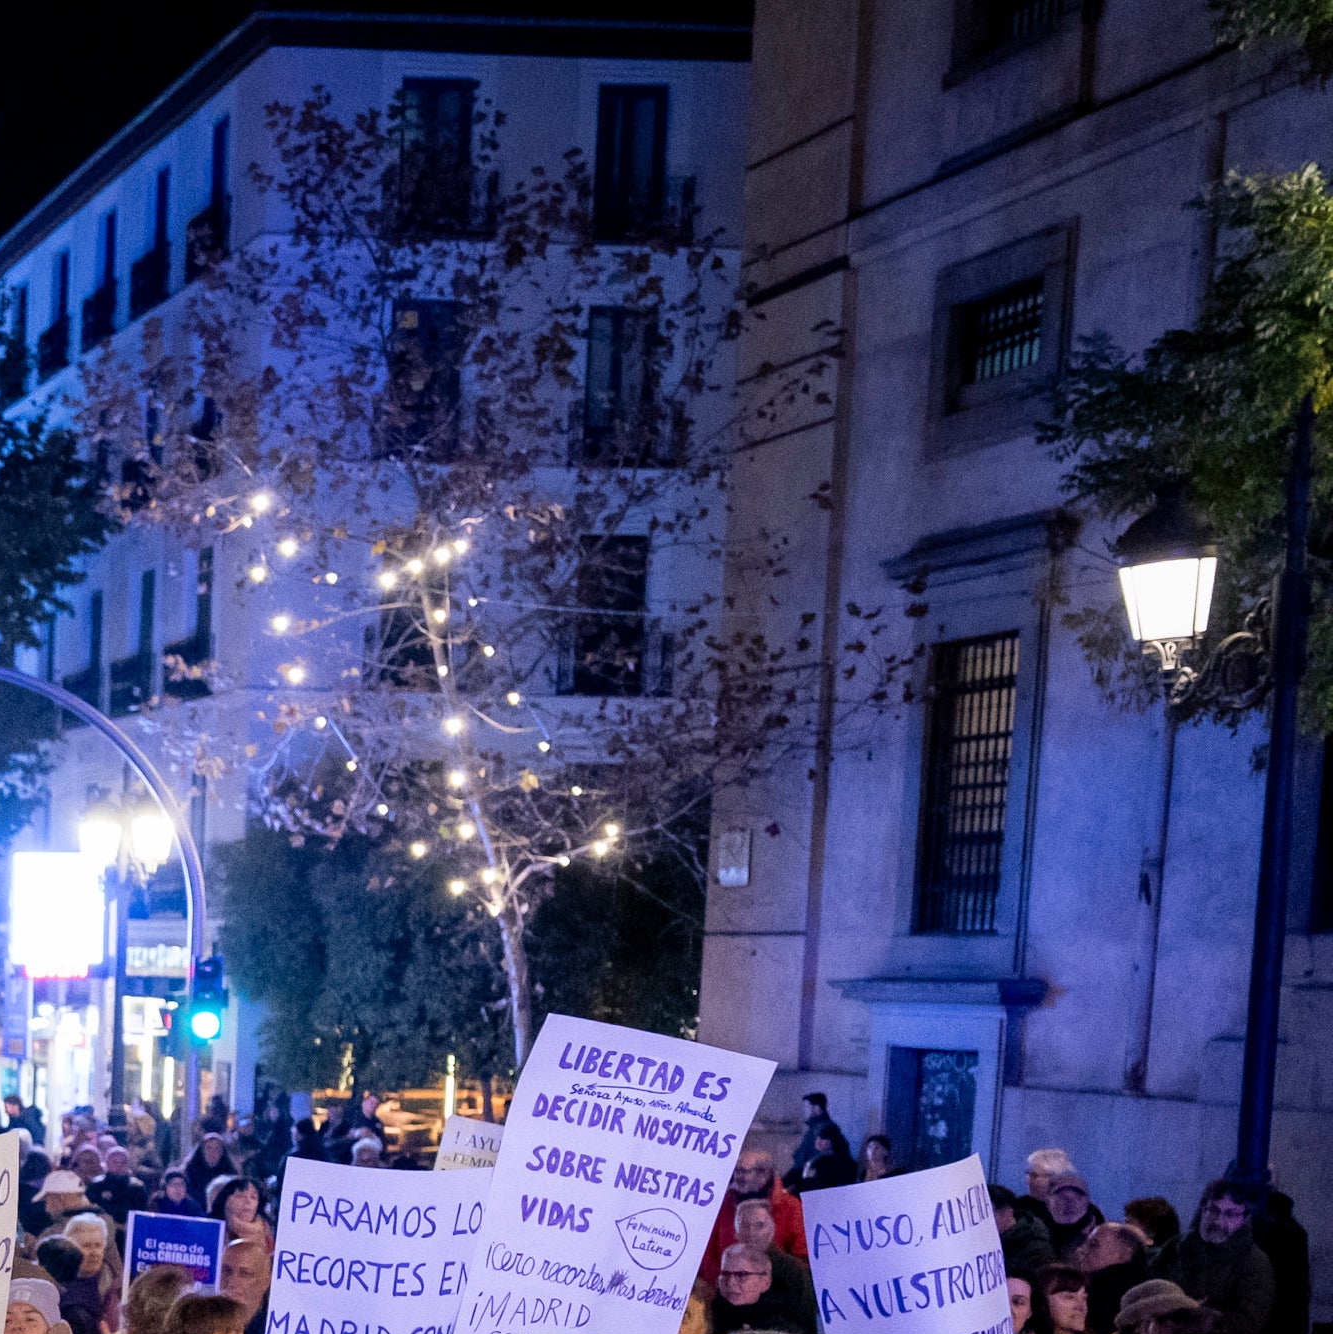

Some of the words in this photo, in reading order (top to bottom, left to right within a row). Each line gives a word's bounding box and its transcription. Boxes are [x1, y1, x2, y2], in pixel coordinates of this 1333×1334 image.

[559, 1042, 685, 1092] LIBERTAD
[693, 1071, 732, 1102] ES
[465, 1134, 502, 1153] AYU
[532, 1093, 626, 1134] DECIDIR
[633, 1114, 737, 1158] NOSOTRAS
[526, 1145, 606, 1184] SOBRE
[291, 1191, 436, 1238] PARAMOS
[452, 1201, 485, 1236] LO
[521, 1194, 593, 1233] VIDAS
[626, 1217, 681, 1242] Feminismo
[138, 1248, 156, 1260] los
[145, 1239, 156, 1248] El
[158, 1241, 187, 1253] caso
[189, 1243, 204, 1254] de
[485, 1242, 535, 1276] ¡Cero
[632, 1235, 672, 1257] Latina
[277, 1250, 427, 1297] RECORTES
[821, 1288, 847, 1324] A
[849, 1262, 975, 1319] VUESTRO
[469, 1292, 591, 1332] ¡MADRID
